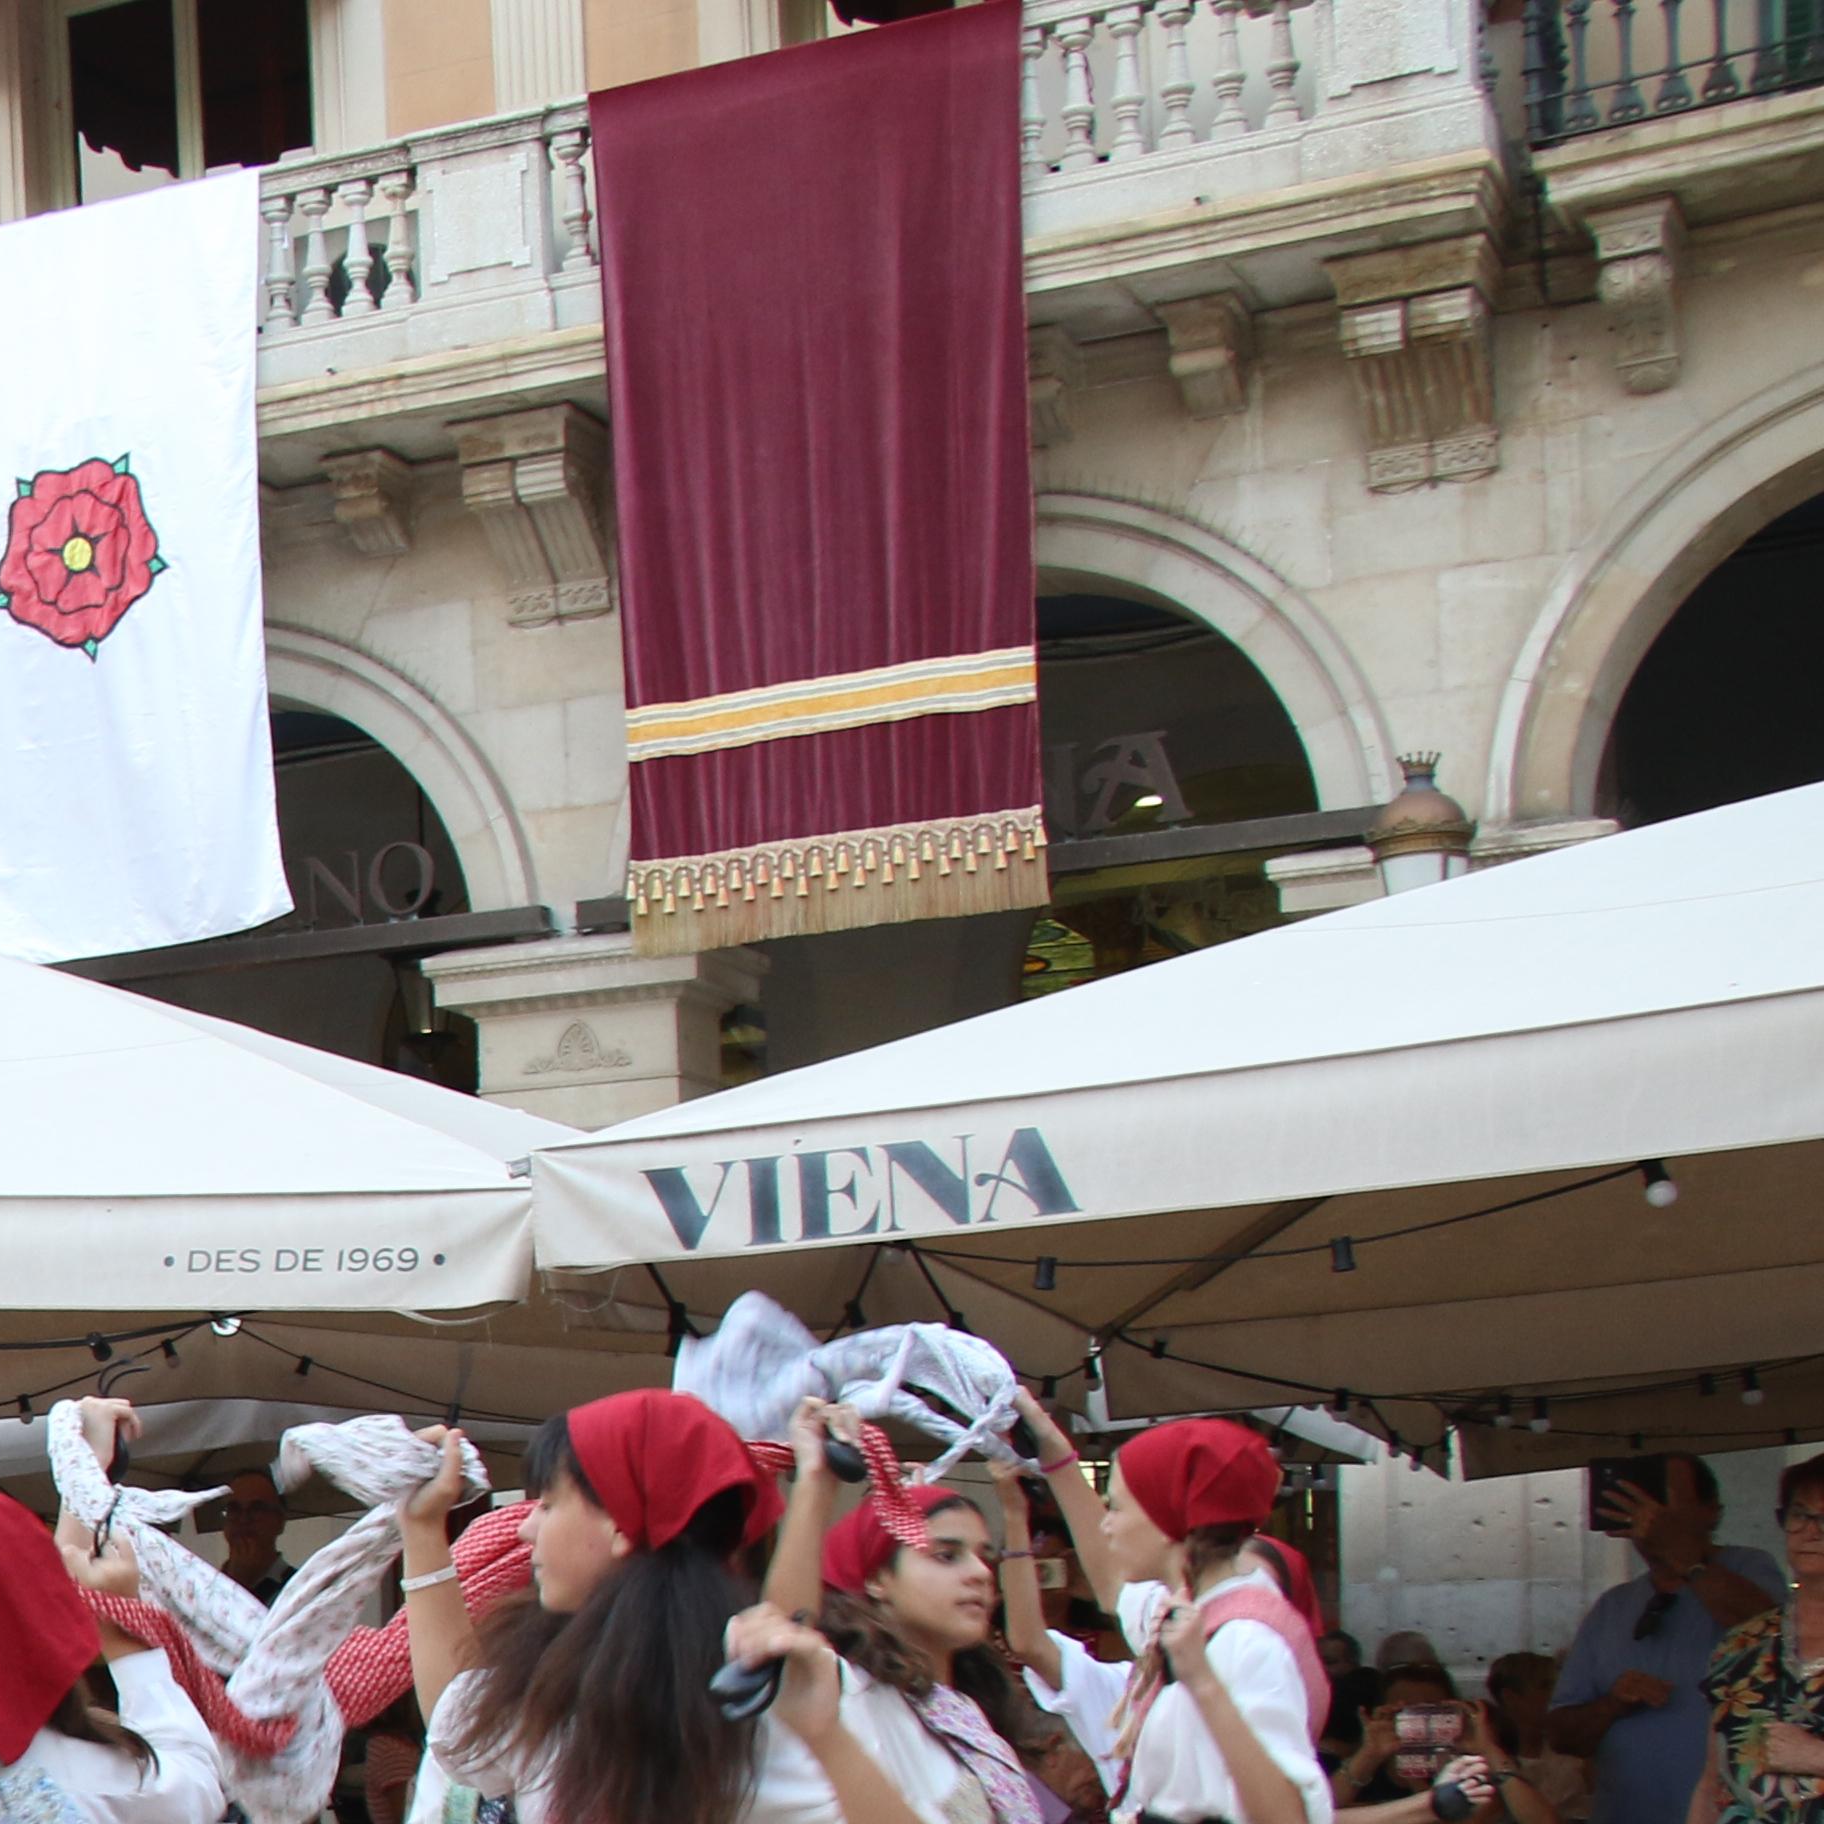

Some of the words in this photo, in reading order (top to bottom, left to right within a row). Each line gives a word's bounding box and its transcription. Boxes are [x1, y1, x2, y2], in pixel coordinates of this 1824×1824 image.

[639, 1126, 1085, 1251] VIENA
[187, 1249, 261, 1273] DES
[274, 1248, 325, 1273] DE
[336, 1247, 419, 1272] 1969
